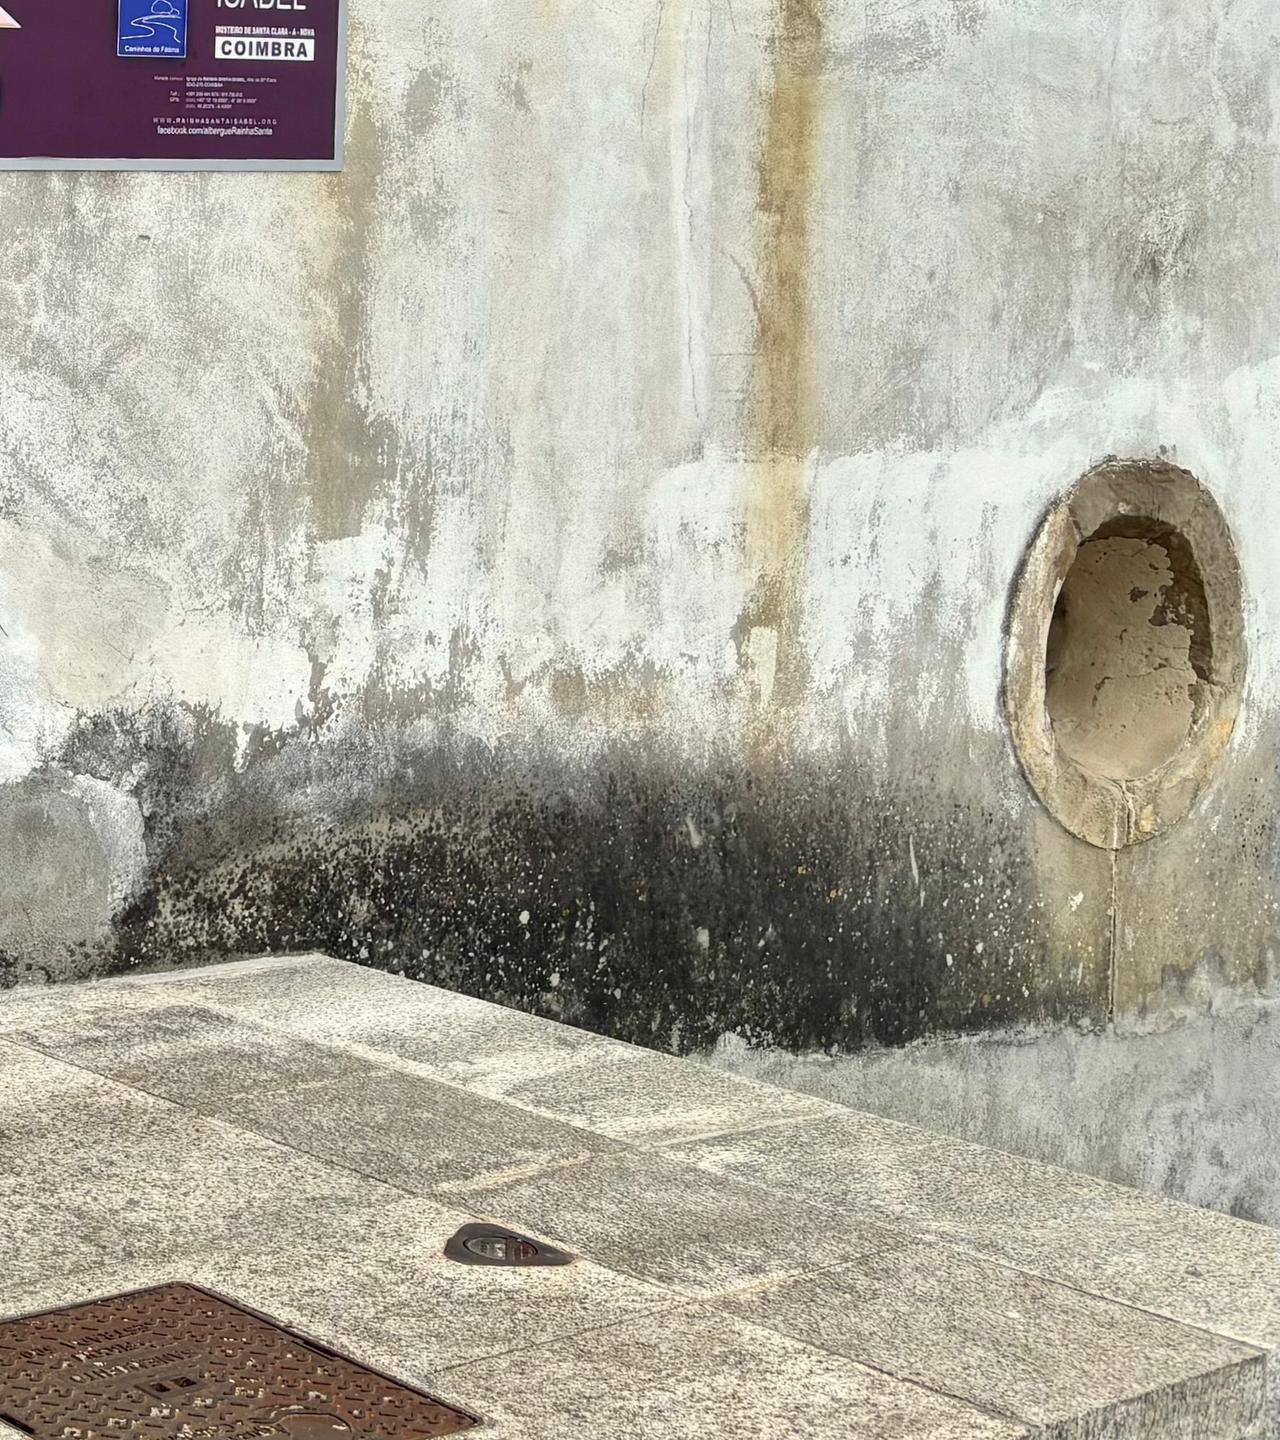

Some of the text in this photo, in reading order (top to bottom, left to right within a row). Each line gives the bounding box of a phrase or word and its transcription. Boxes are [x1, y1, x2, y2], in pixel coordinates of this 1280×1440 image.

[244, 26, 251, 35] DE
[252, 26, 270, 35] SANTA
[271, 27, 288, 35] CLARA
[221, 40, 308, 58] COIMBRA
